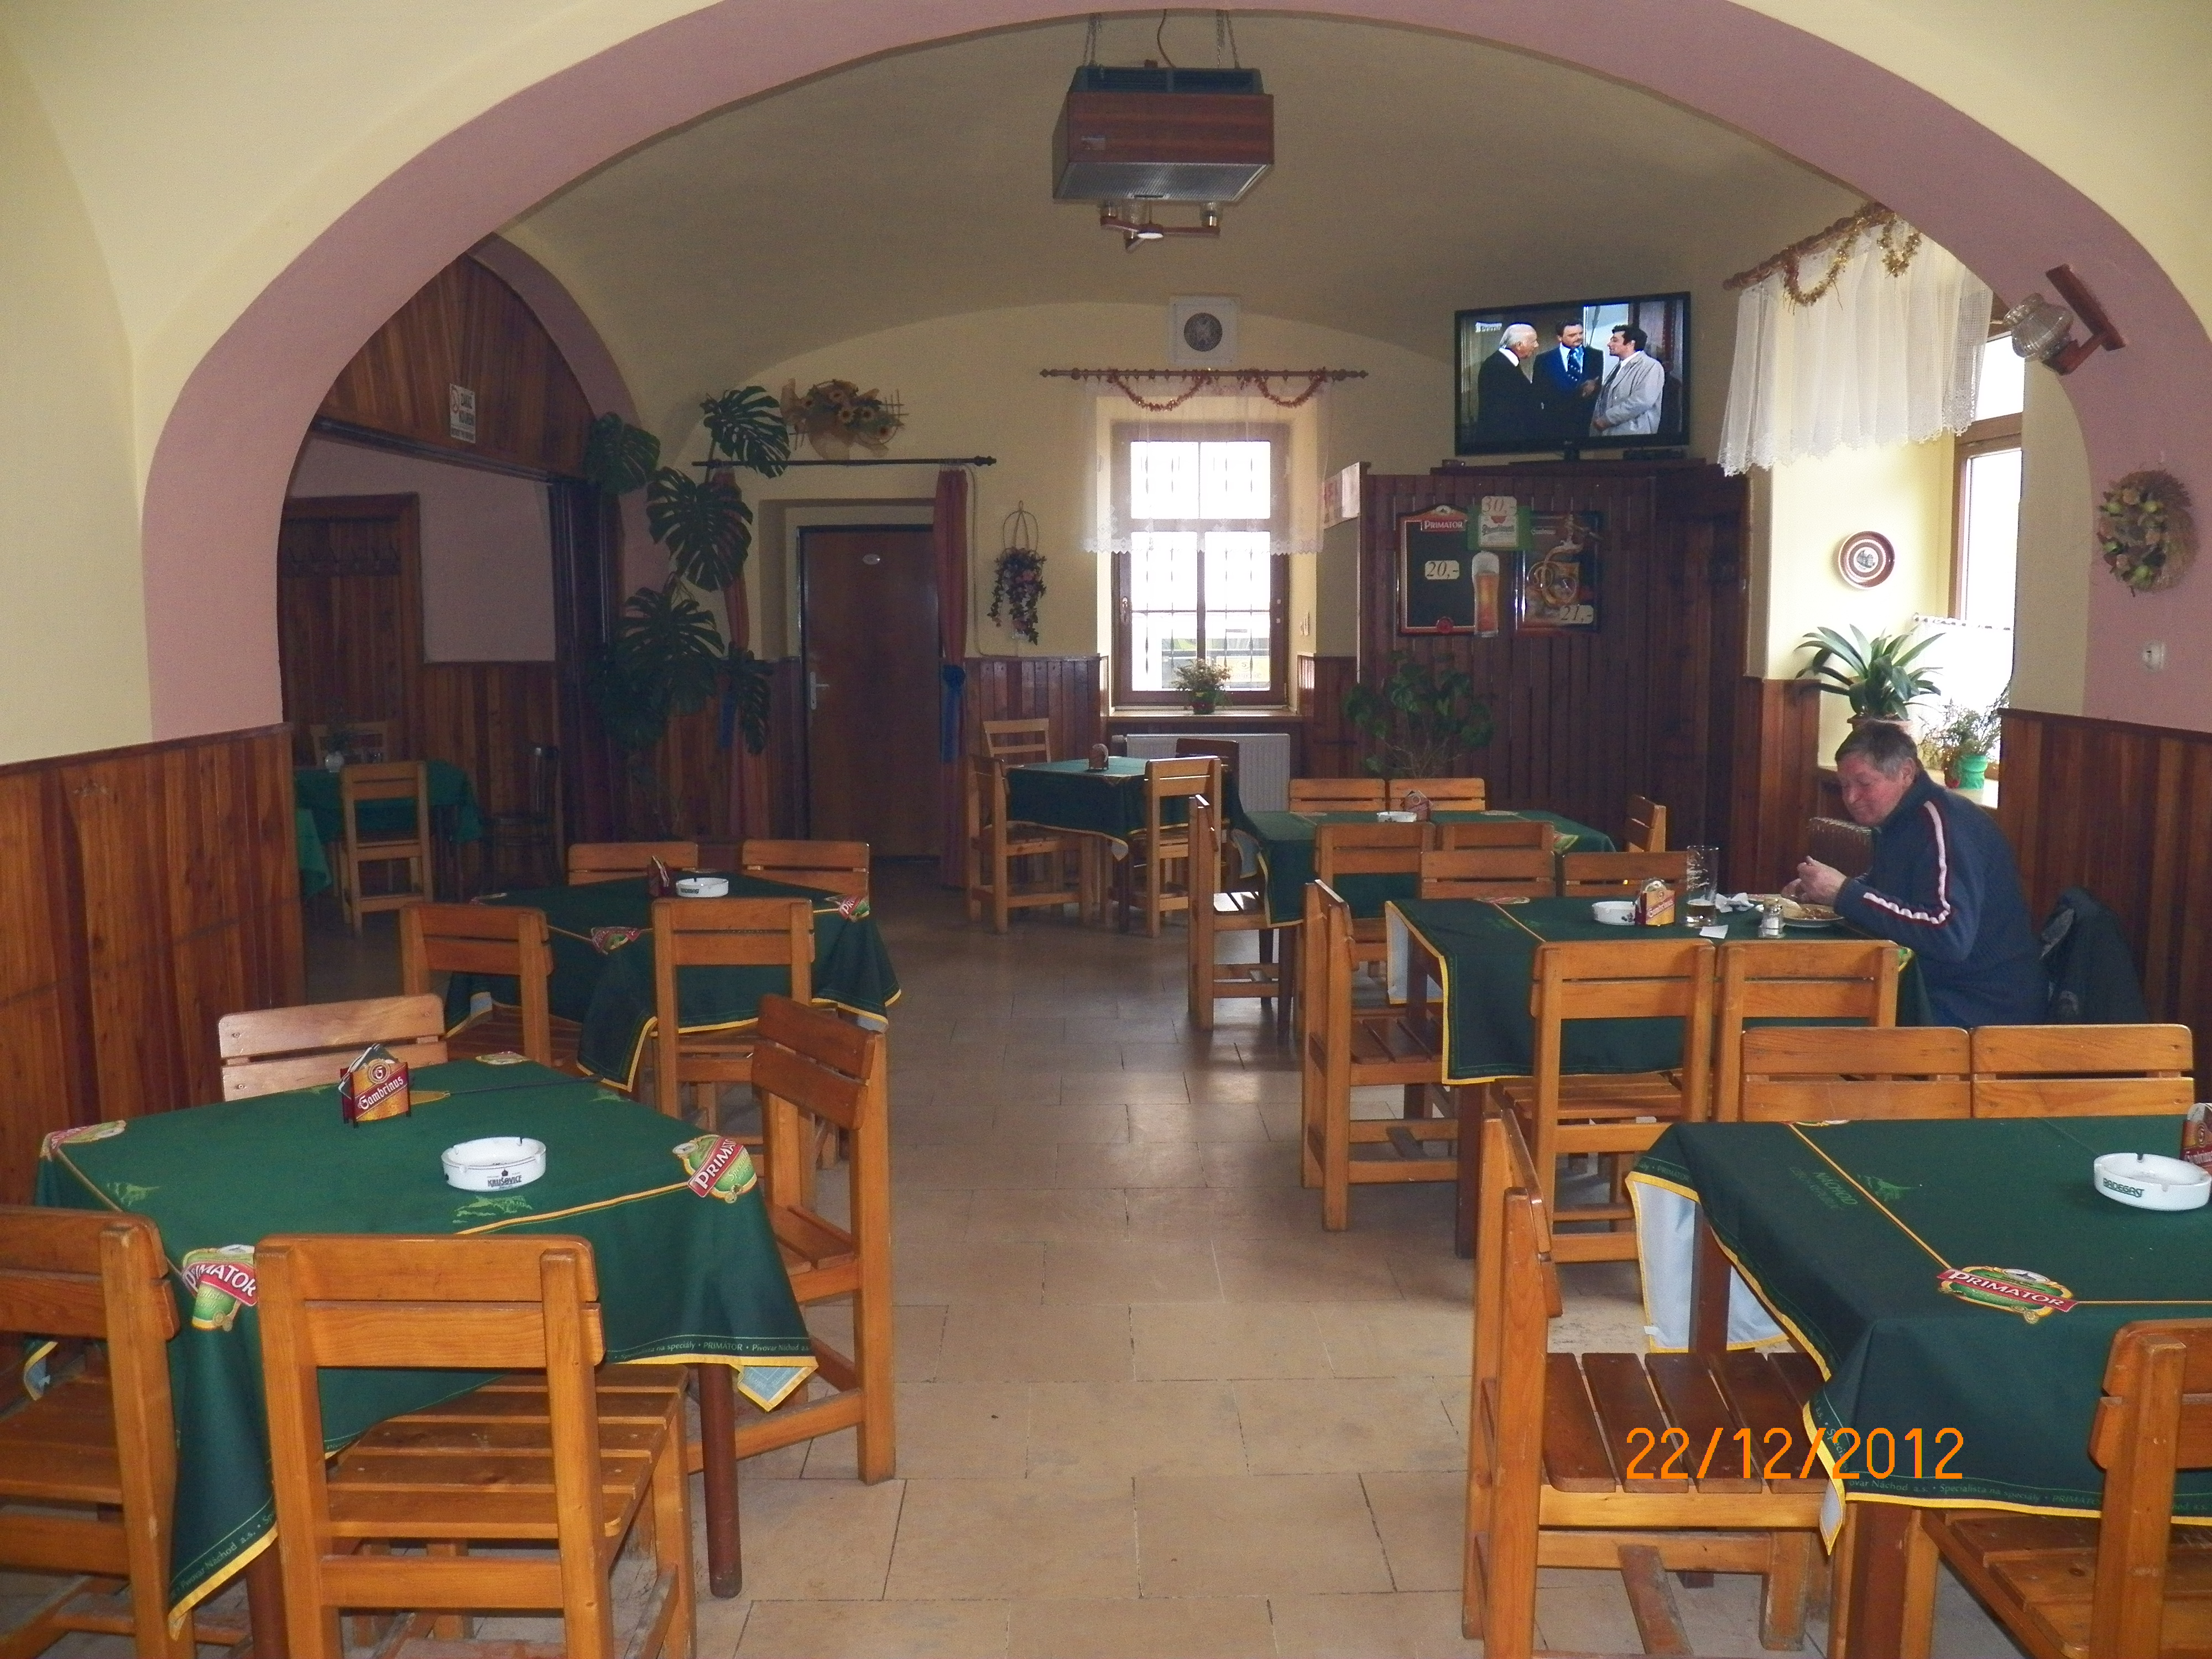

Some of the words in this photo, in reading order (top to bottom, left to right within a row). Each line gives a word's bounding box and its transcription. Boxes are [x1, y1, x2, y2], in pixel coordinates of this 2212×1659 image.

[1424, 520, 1463, 529] PRIMATOR
[1427, 561, 1459, 578] 20,-
[1561, 606, 1592, 623] 21,-
[357, 1076, 404, 1110] Gambrinus
[2103, 1177, 2145, 1198] RADEGAST
[1948, 1271, 2065, 1306] PRIMATOR
[667, 1340, 696, 1352] speciály
[703, 1340, 743, 1351] PRIMÁTOR
[1871, 1479, 1909, 1491] Náchod
[1939, 1483, 1987, 1494] Specialista
